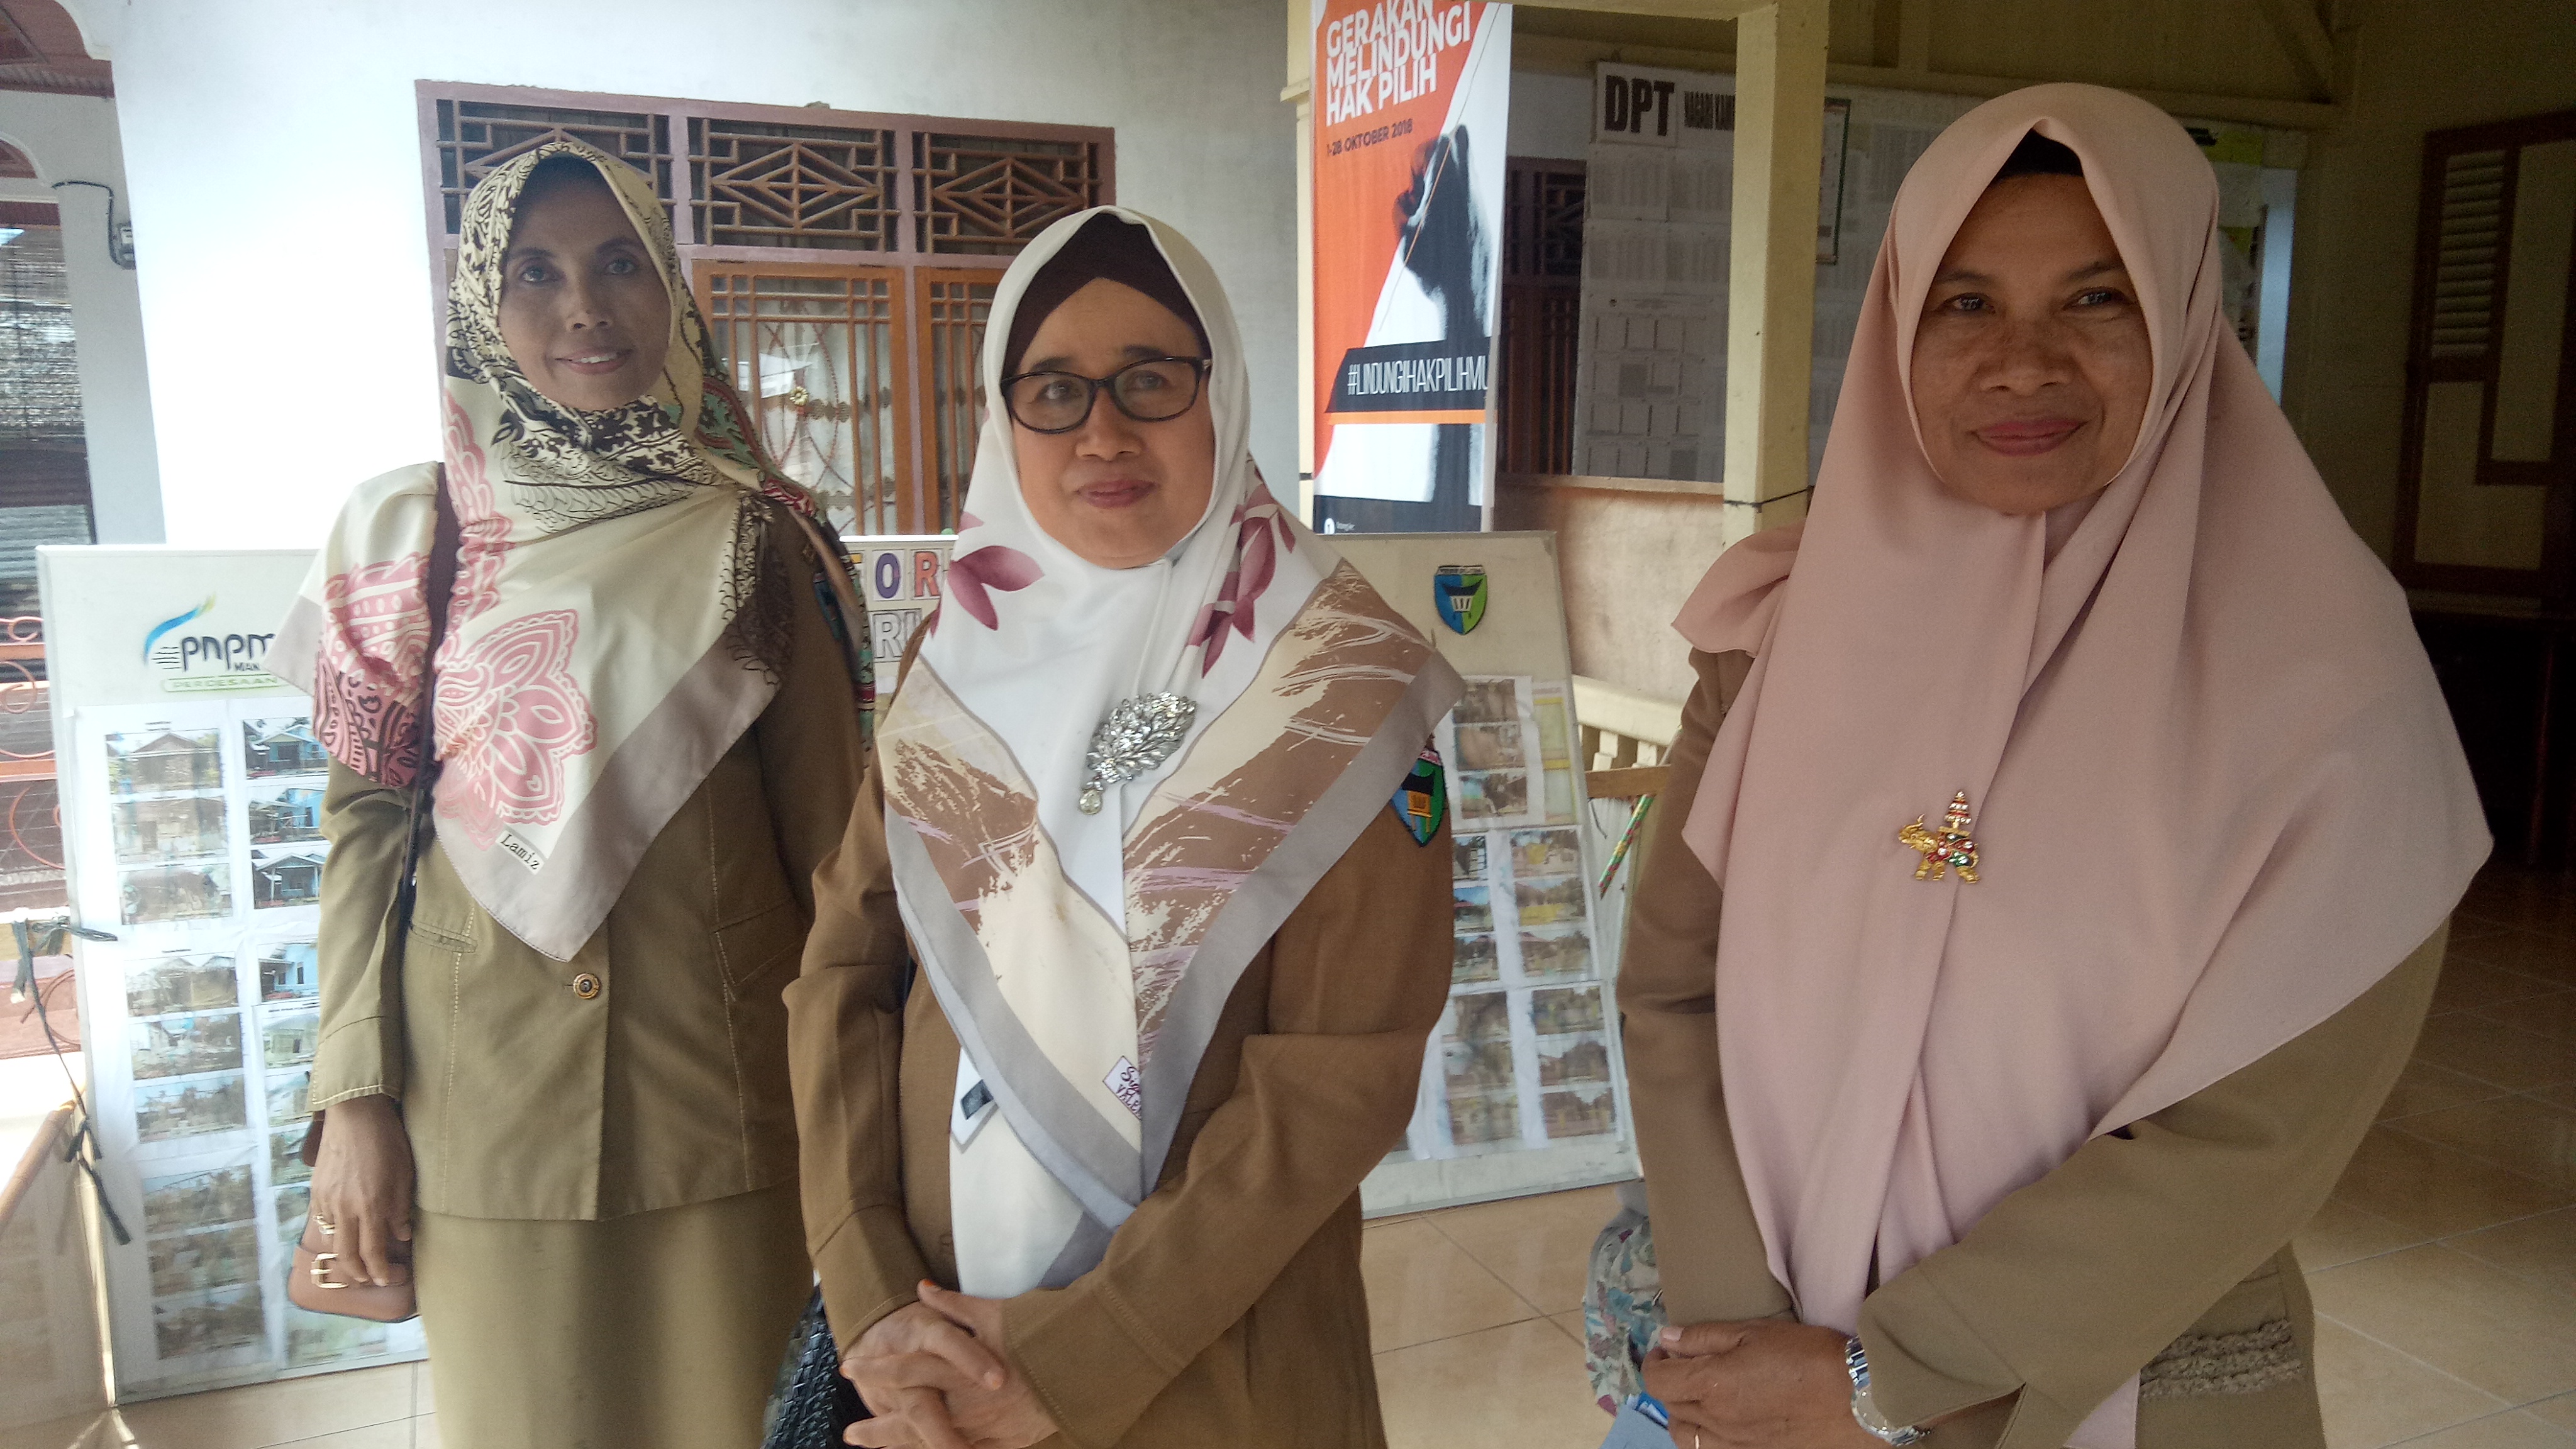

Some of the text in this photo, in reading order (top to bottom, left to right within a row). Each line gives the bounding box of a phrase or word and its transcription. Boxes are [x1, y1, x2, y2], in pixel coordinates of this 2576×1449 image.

[1326, 0, 1434, 58] GERAKAN
[1326, 1, 1471, 89] MELINDUNGI
[1326, 52, 1437, 128] HAK PILIH
[1604, 75, 1675, 137] DPT
[1344, 126, 1389, 152] OKTOBER
[500, 833, 540, 870] Lamiz
